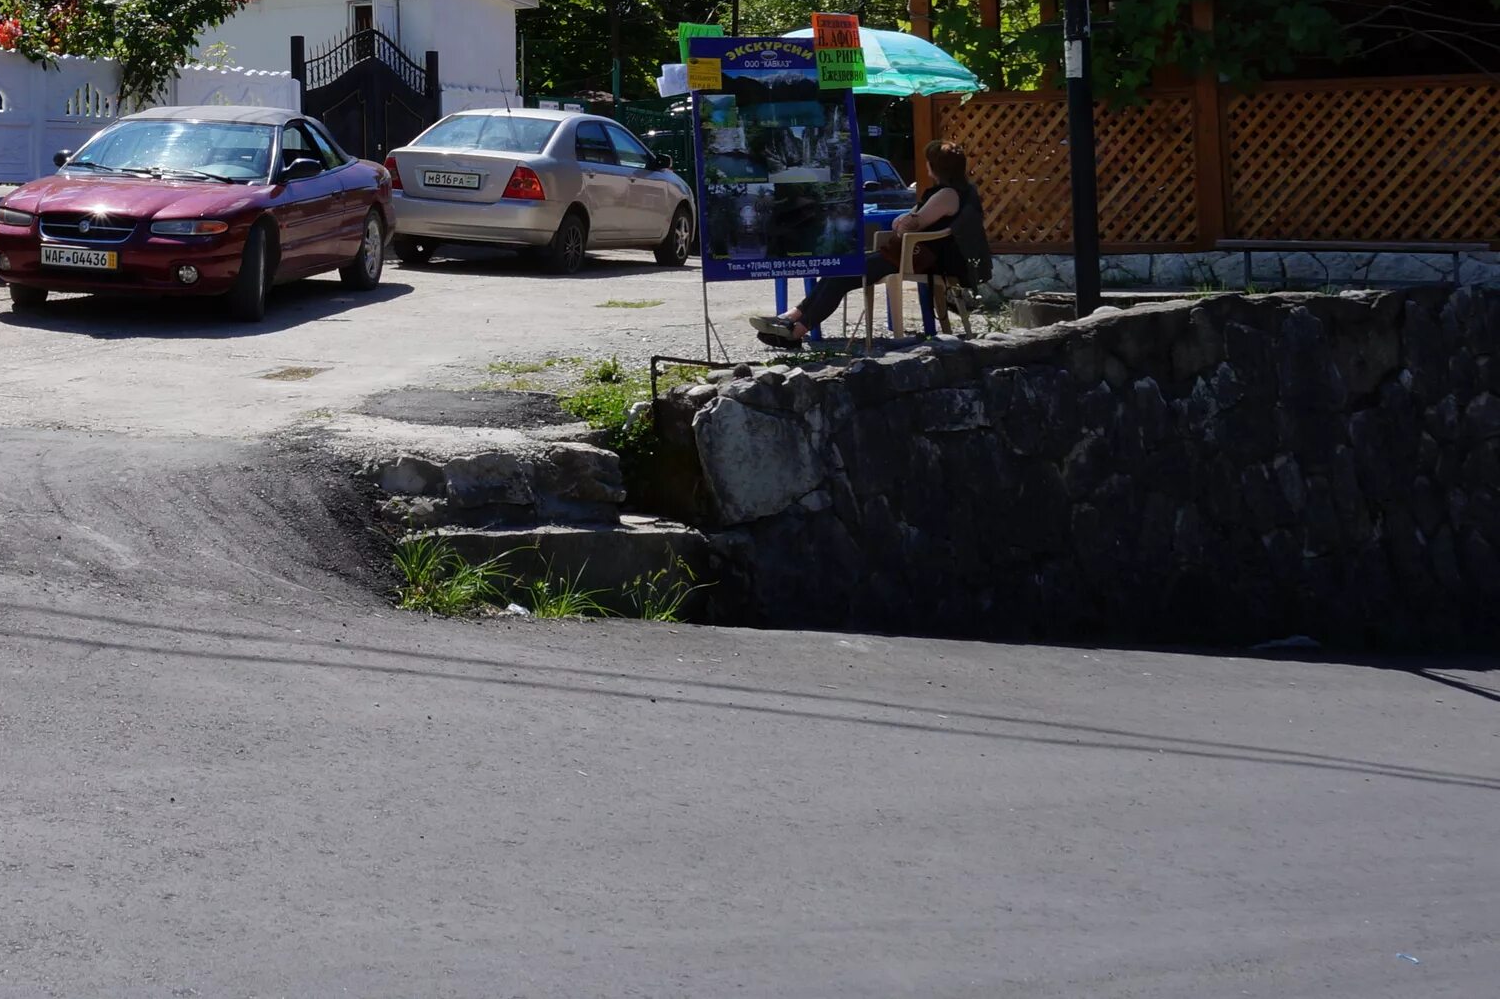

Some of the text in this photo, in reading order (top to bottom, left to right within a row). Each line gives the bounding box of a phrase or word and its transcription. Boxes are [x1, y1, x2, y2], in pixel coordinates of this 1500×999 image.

[725, 42, 813, 61] ЭКСКУРСИИ
[836, 49, 865, 64] РИЦА
[744, 60, 760, 68] ООО
[821, 66, 864, 82] Ежедневно
